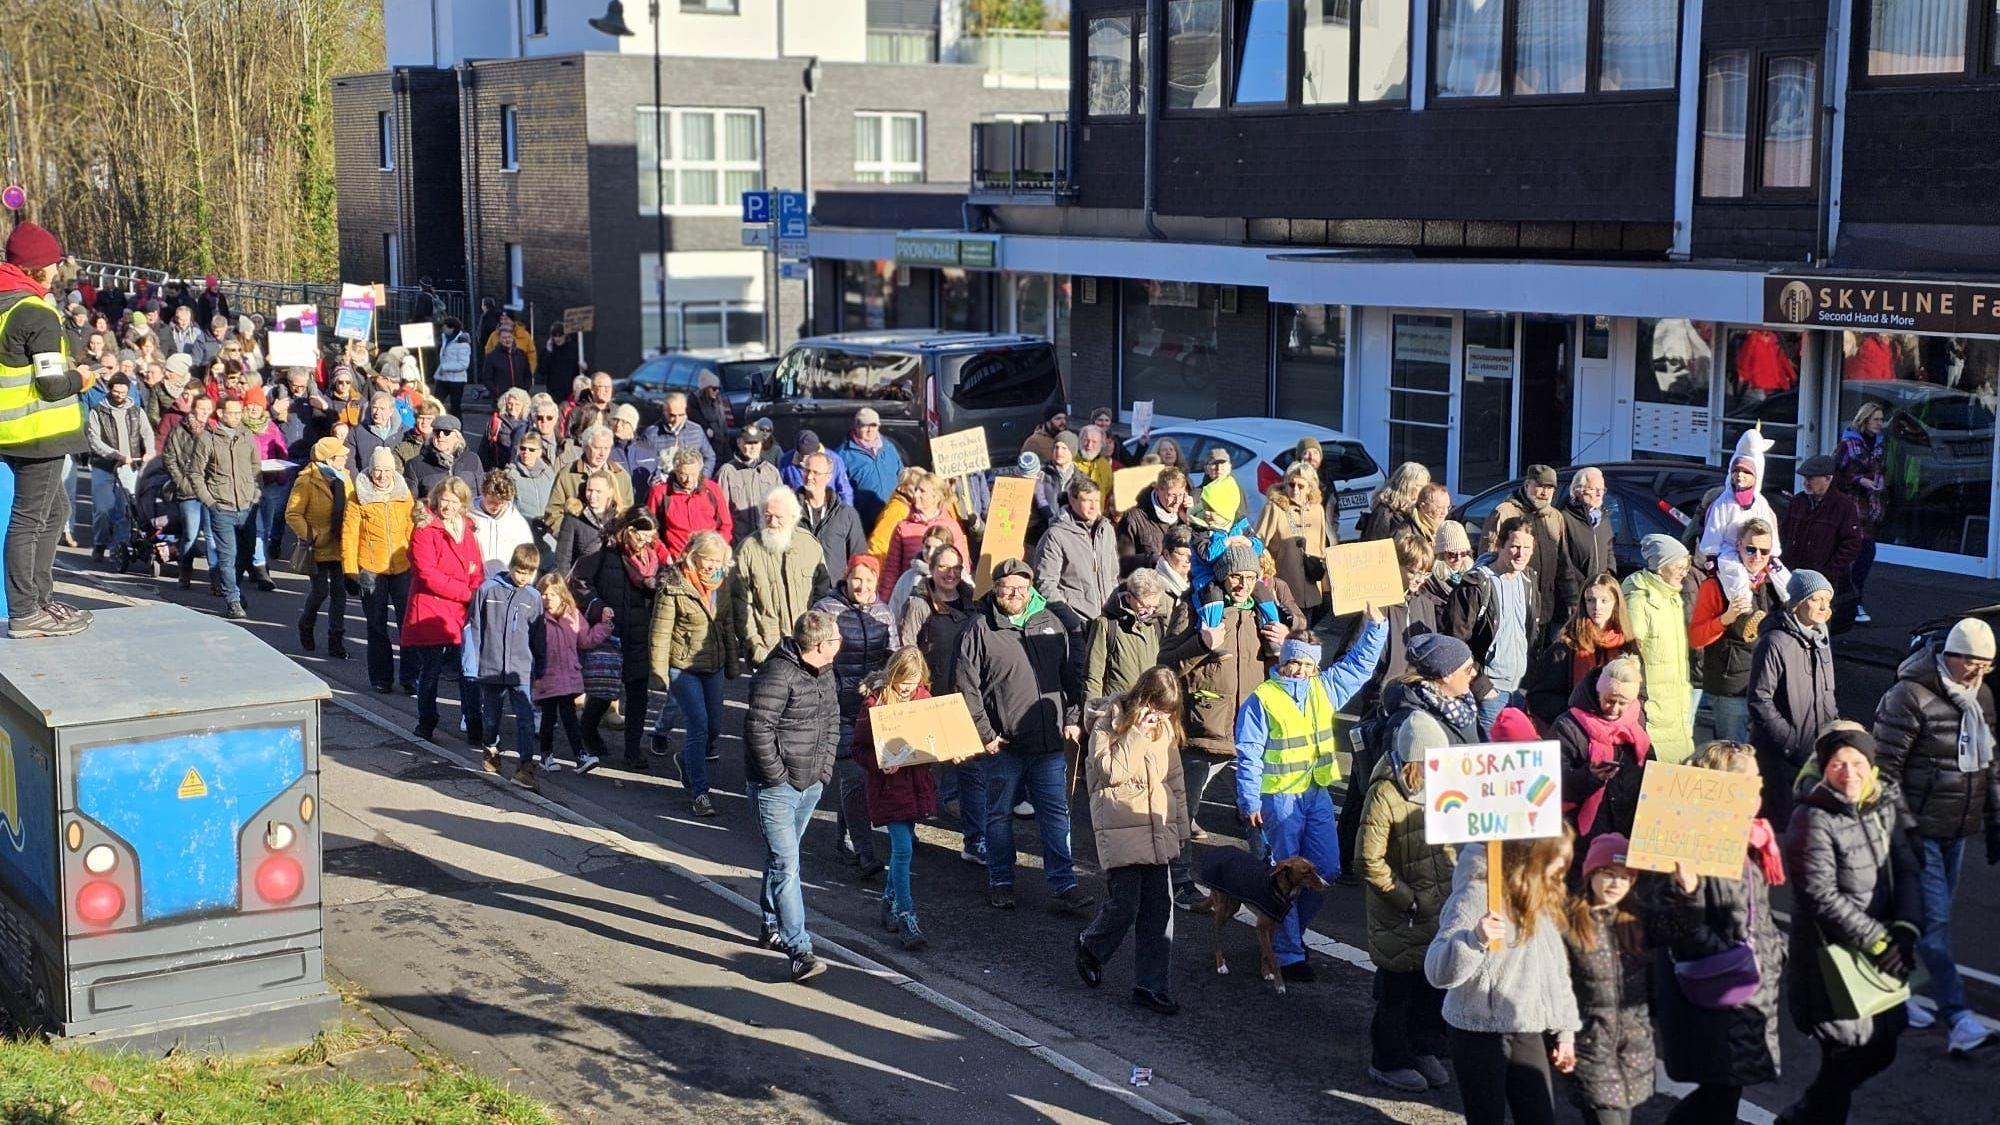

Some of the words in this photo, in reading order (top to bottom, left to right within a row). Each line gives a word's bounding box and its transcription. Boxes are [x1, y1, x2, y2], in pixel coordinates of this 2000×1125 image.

[748, 196, 763, 219] P
[783, 195, 795, 214] P
[896, 242, 956, 260] PROVINZIAL
[1819, 287, 1954, 314] SKYLINE
[1818, 310, 1853, 323] Second
[1855, 312, 1879, 324] Hand
[1880, 313, 1888, 324] &
[1890, 314, 1915, 326] More
[1442, 749, 1543, 776] ÖSRATH
[1481, 780, 1524, 798] BLIBT
[1668, 772, 1738, 803] NAZIS
[1467, 810, 1538, 836] BUN!
